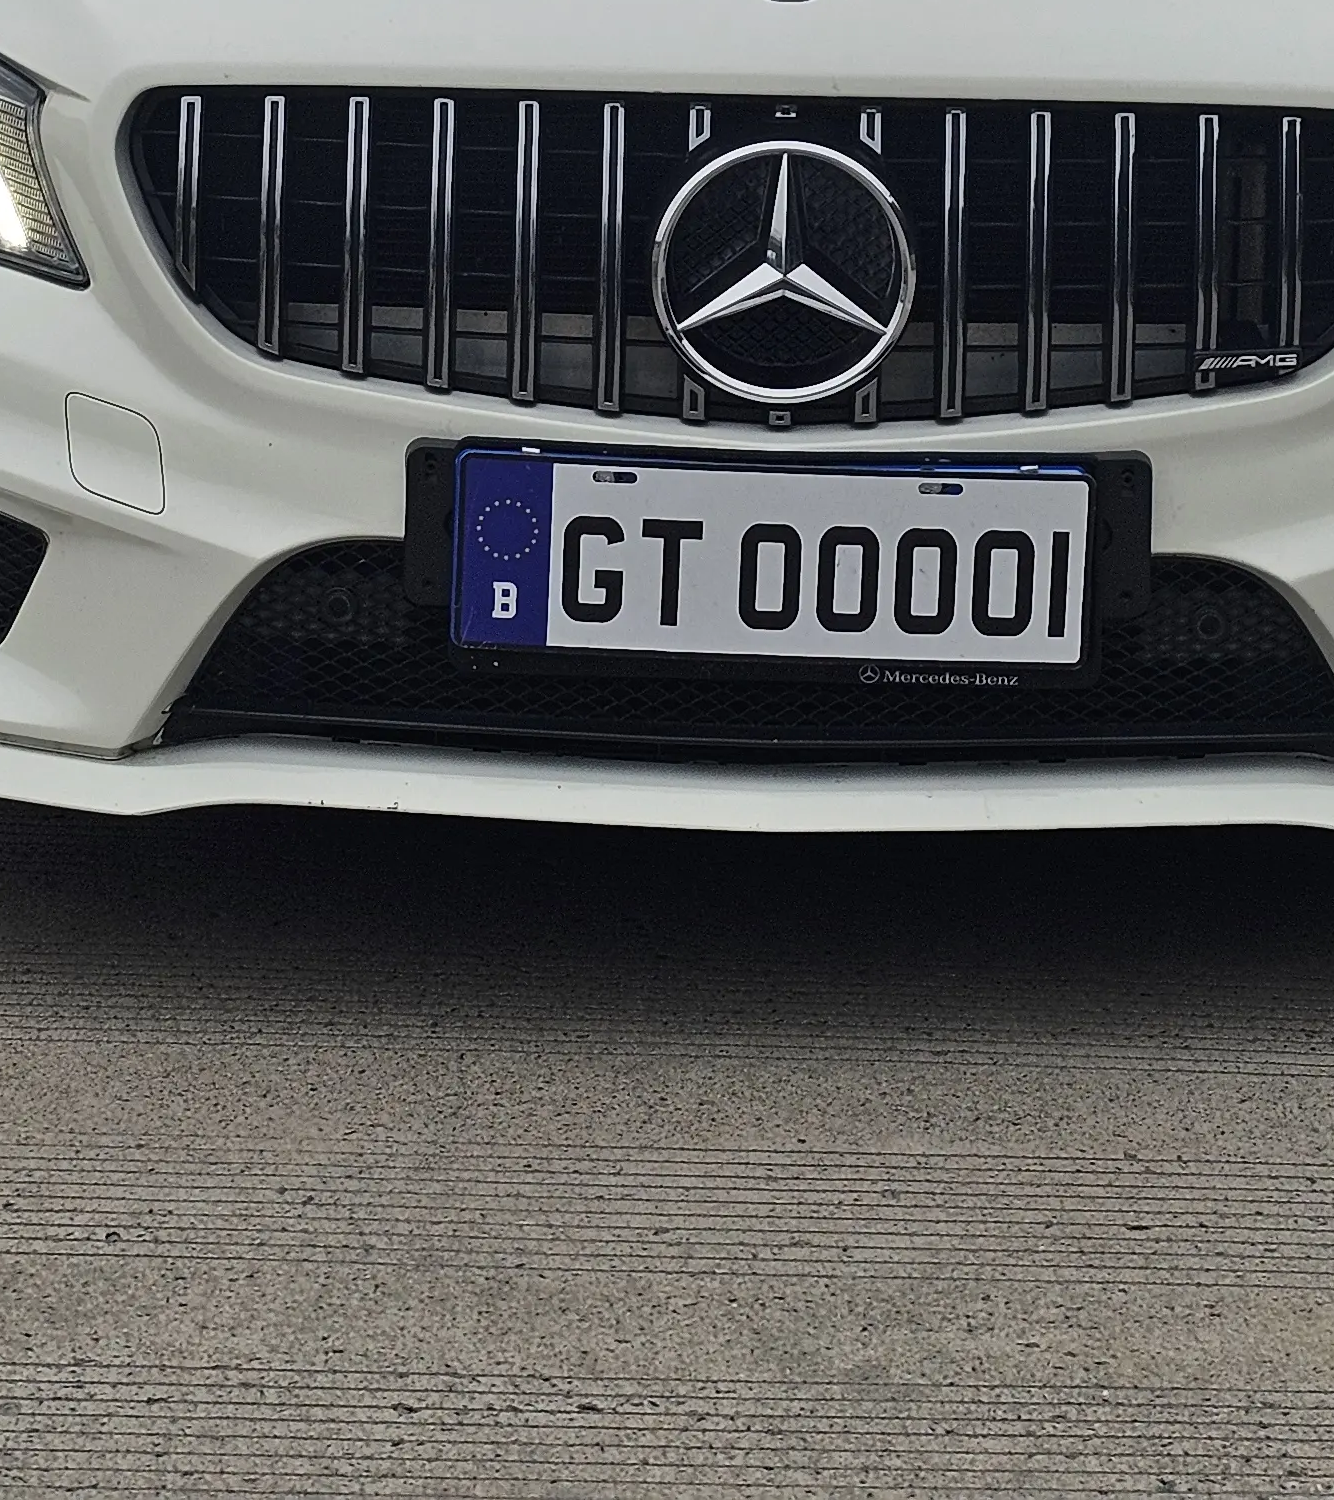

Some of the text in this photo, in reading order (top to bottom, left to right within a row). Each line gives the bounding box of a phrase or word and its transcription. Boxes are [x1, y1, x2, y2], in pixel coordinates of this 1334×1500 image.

[1231, 353, 1298, 368] AMG
[561, 515, 704, 627] GT
[492, 581, 518, 619] B
[882, 670, 1019, 686] Mercedes-Benz
